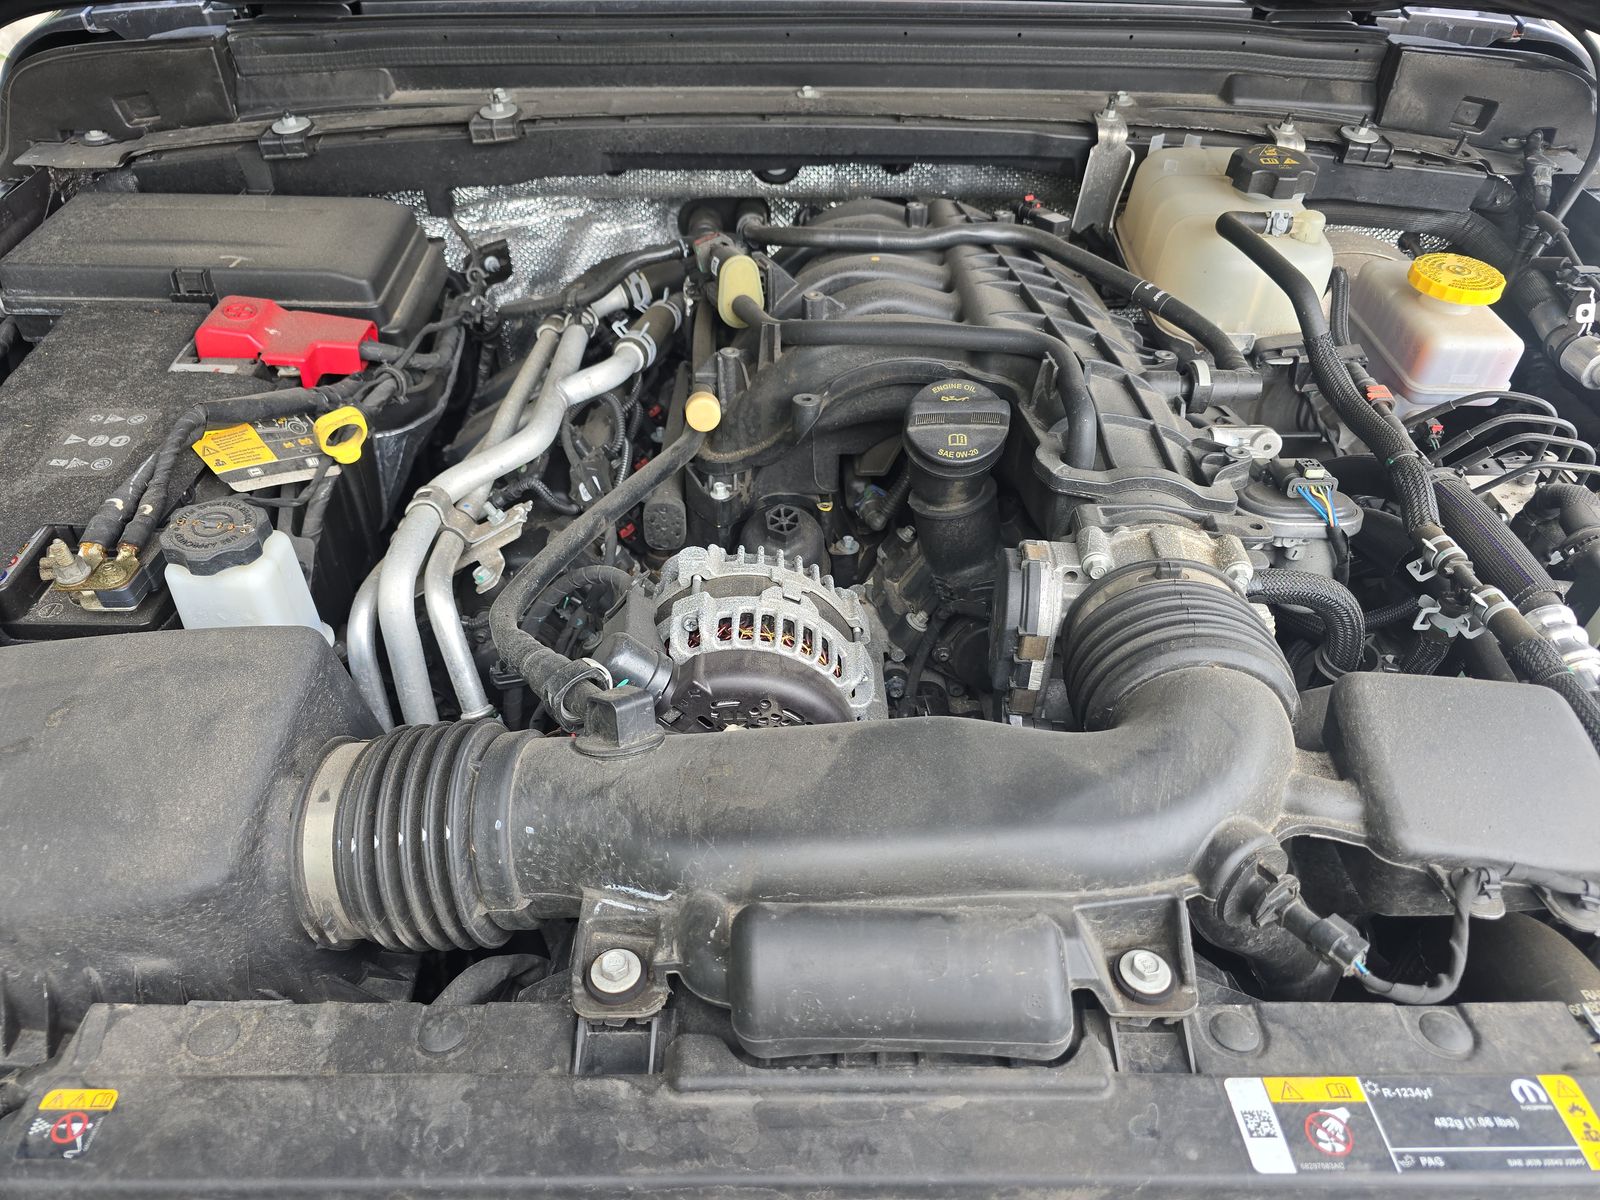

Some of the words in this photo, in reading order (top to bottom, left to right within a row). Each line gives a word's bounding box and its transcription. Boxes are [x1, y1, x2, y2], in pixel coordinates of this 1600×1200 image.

[931, 383, 962, 394] ENGINE
[963, 384, 977, 394] OIL
[937, 448, 954, 459] SAE
[955, 448, 979, 458] 0W-20
[1381, 1087, 1433, 1100] R-1234yf
[1434, 1116, 1465, 1130] 482g
[1419, 1156, 1445, 1167] PAG
